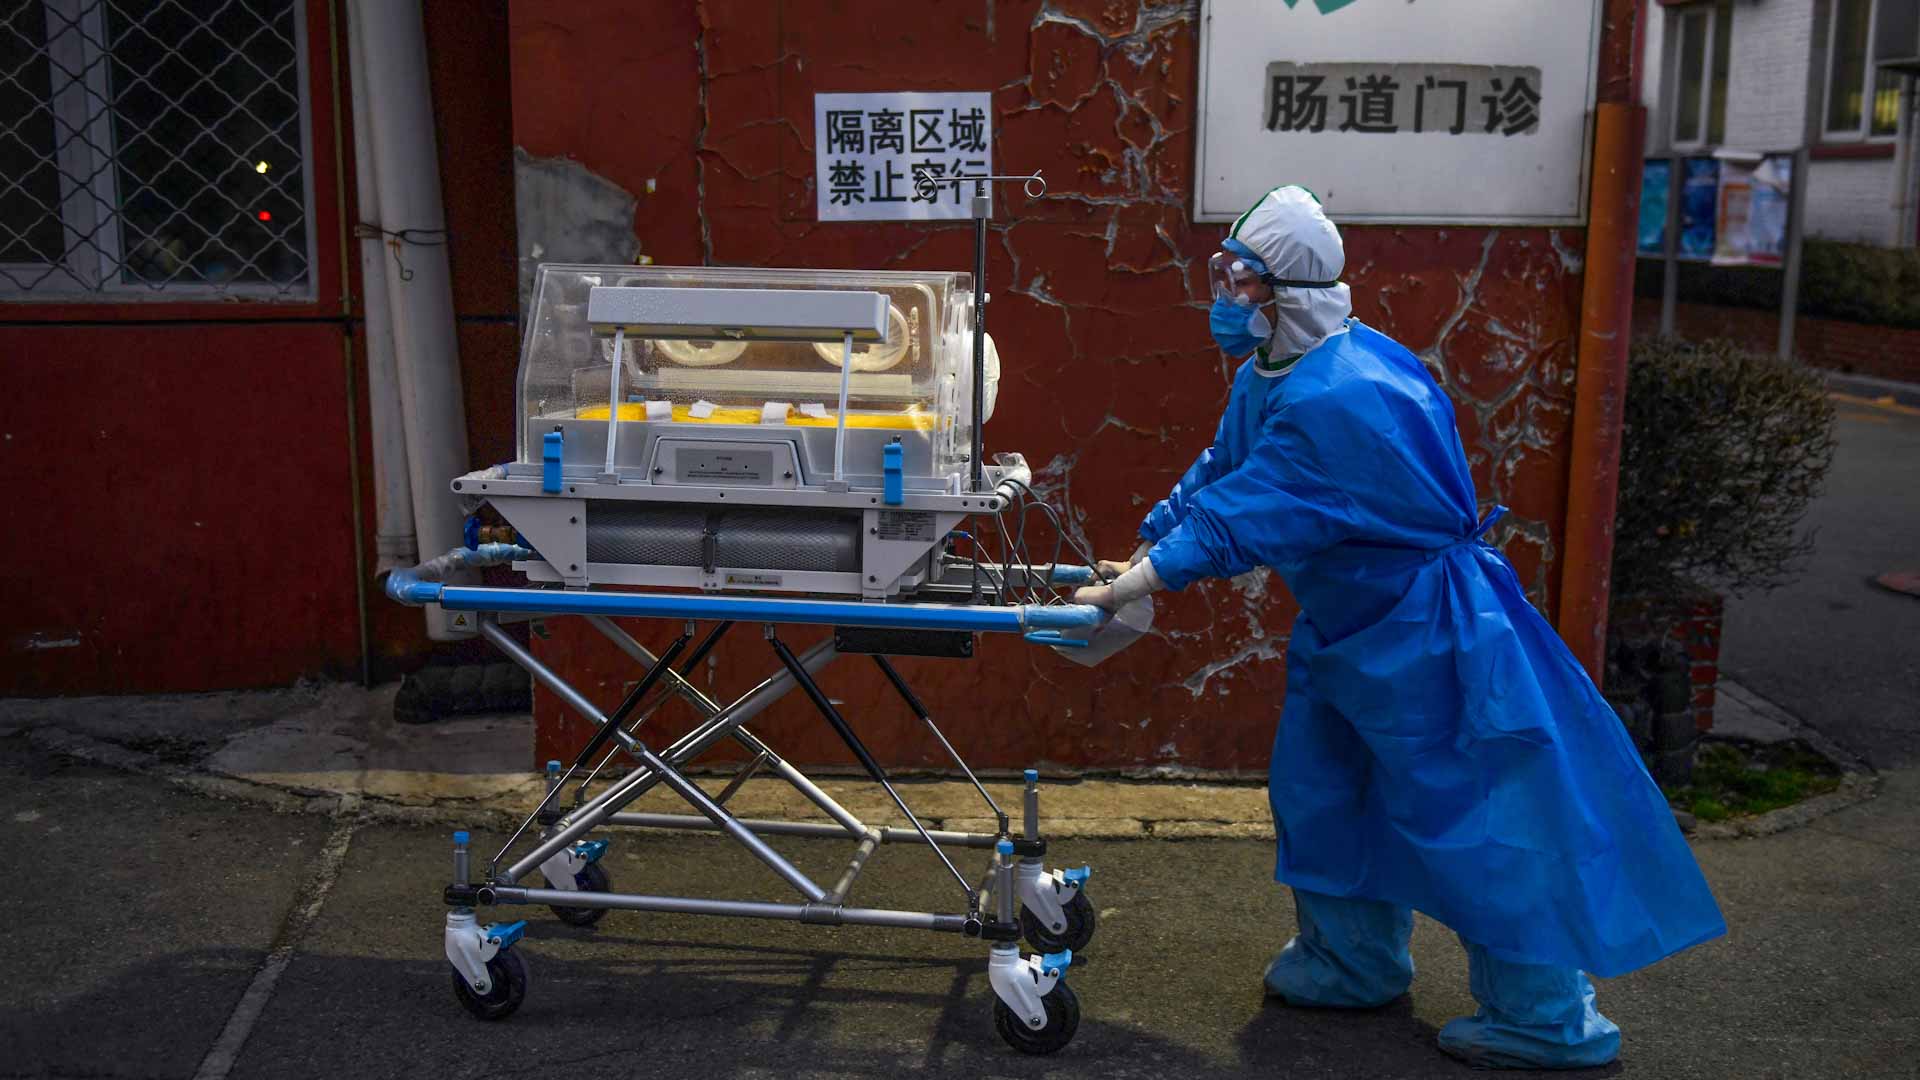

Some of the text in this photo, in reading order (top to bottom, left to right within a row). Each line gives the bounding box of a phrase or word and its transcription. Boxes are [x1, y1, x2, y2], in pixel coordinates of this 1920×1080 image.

[1266, 74, 1541, 136] 肠道门诊
[826, 108, 987, 154] 隔离区域
[828, 158, 987, 206] 禁止穿行
